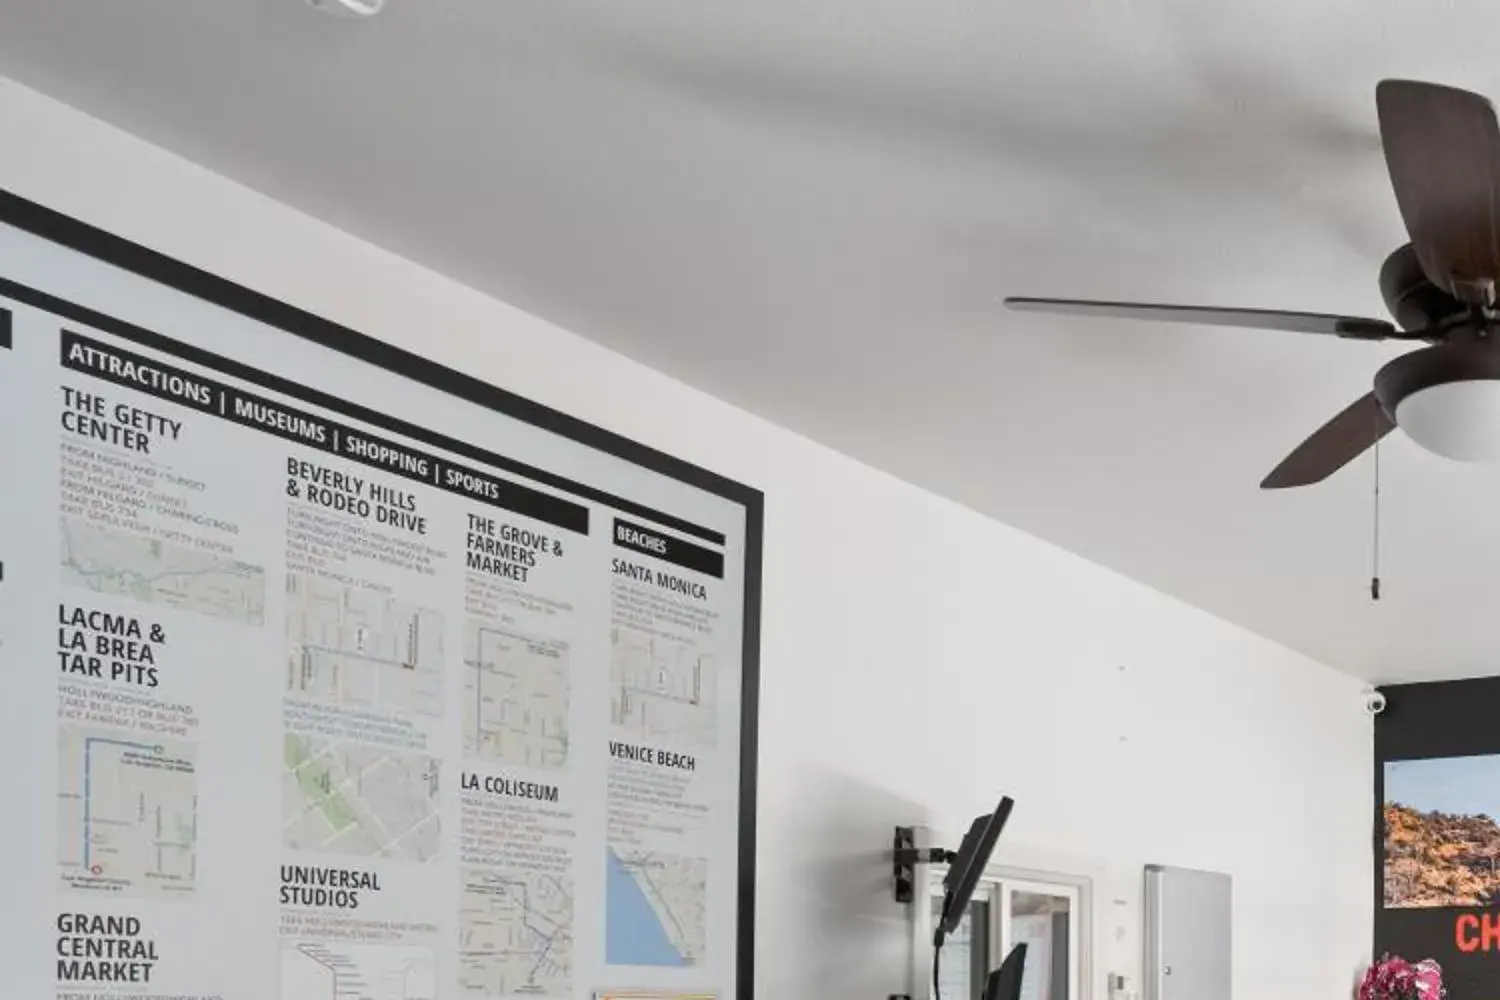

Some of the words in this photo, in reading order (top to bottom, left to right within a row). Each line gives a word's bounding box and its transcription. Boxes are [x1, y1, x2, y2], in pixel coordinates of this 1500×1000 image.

[61, 385, 105, 418] THE
[115, 403, 183, 441] GETTY
[70, 342, 212, 405] ATTRACTIONS
[234, 400, 326, 444] MUSEUMS
[347, 437, 429, 476] SHOPPING
[446, 468, 500, 500] SPORTS
[61, 411, 150, 454] CENTER
[287, 457, 365, 497] BEVERLY
[370, 483, 416, 512] HILLS
[286, 478, 300, 498] &
[307, 484, 370, 518] RODEO
[376, 504, 427, 535] DRIVE
[467, 512, 496, 537] THE
[500, 523, 549, 553] GROVE
[552, 539, 563, 558] &
[467, 532, 536, 567] FARMERS
[616, 525, 667, 554] BEACHES
[466, 550, 528, 583] MARKET
[611, 557, 653, 585] SANTA
[657, 571, 708, 601] MONICA
[58, 603, 142, 640] LACMA
[149, 622, 166, 645] &
[58, 627, 87, 652] LA
[96, 633, 155, 665] BREA
[57, 651, 102, 679] TAR
[111, 661, 159, 688] PITS
[609, 741, 653, 764] VENICE
[657, 750, 696, 772] BEACH
[461, 771, 480, 792] LA
[484, 775, 559, 803] COLISEUM
[280, 865, 381, 891] UNIVERSAL
[279, 885, 359, 909] STUDIOS
[57, 912, 141, 936] GRAND
[57, 936, 159, 961] CENTRAL
[57, 959, 153, 982] MARKET
